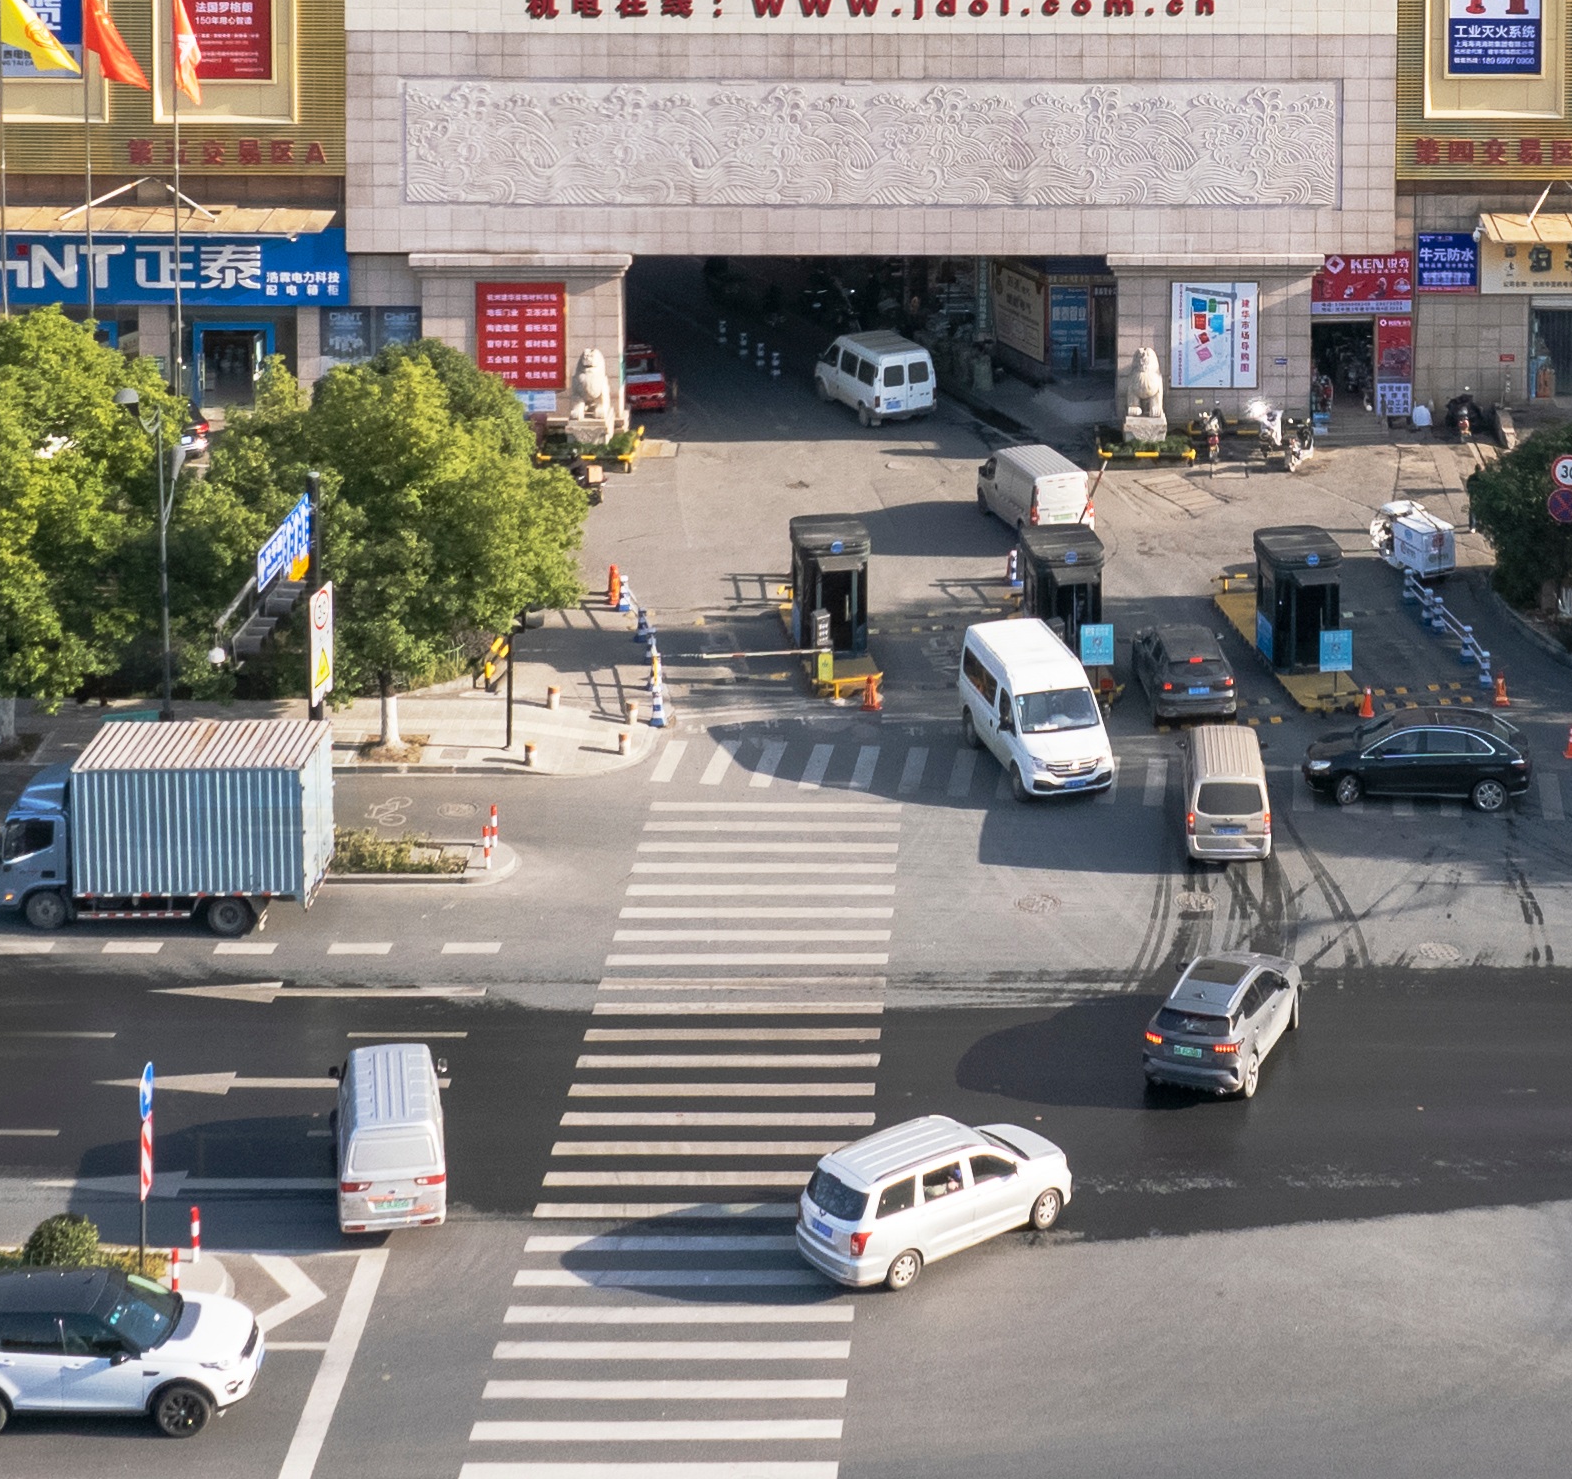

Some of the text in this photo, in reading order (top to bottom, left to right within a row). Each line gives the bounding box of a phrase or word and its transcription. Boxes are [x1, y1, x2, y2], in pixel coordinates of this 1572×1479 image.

[1454, 25, 1536, 38] 工业灭火系统
[1419, 247, 1475, 262] 牛元防水
[135, 244, 262, 289] 正泰
[1350, 258, 1385, 269] KEN
